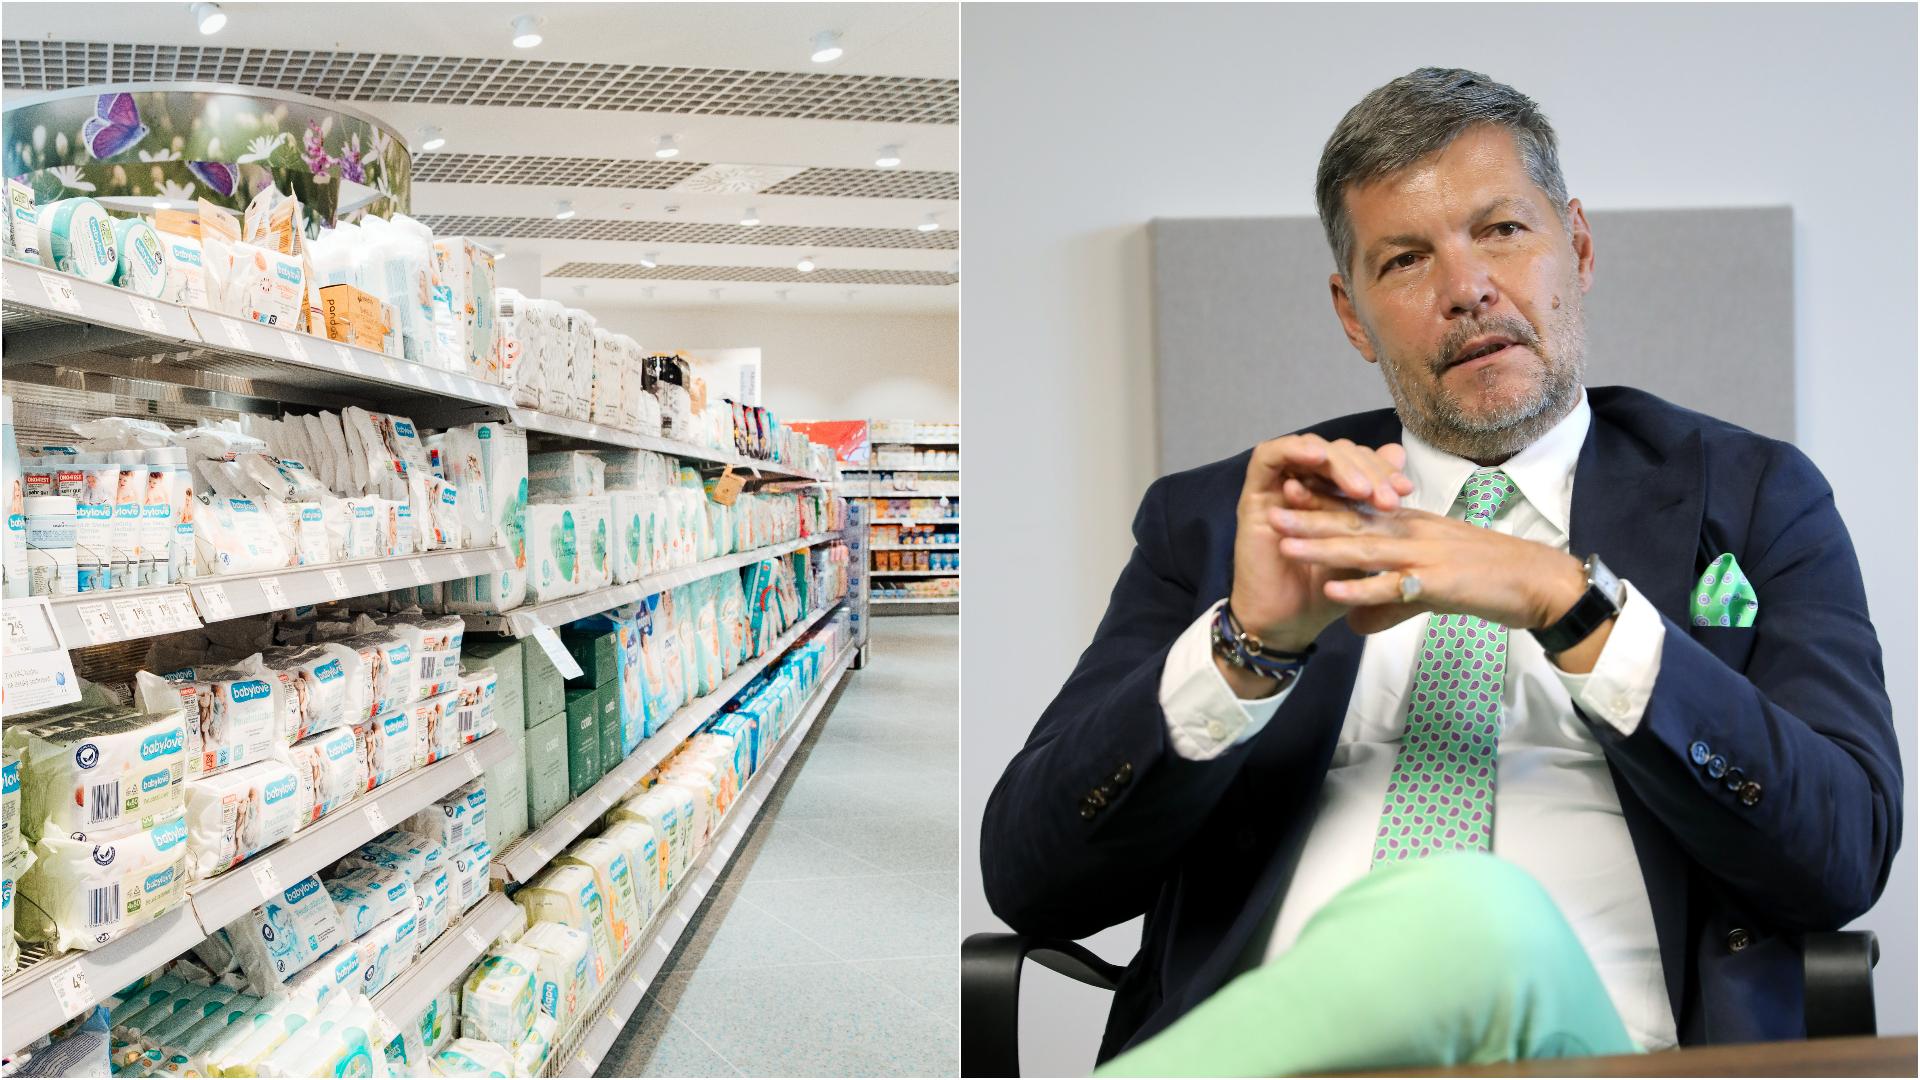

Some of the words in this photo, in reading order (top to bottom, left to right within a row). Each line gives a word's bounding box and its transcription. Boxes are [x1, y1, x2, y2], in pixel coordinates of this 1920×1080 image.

[234, 683, 269, 698] babylove
[143, 737, 182, 757] babylove
[286, 879, 318, 901] babylove
